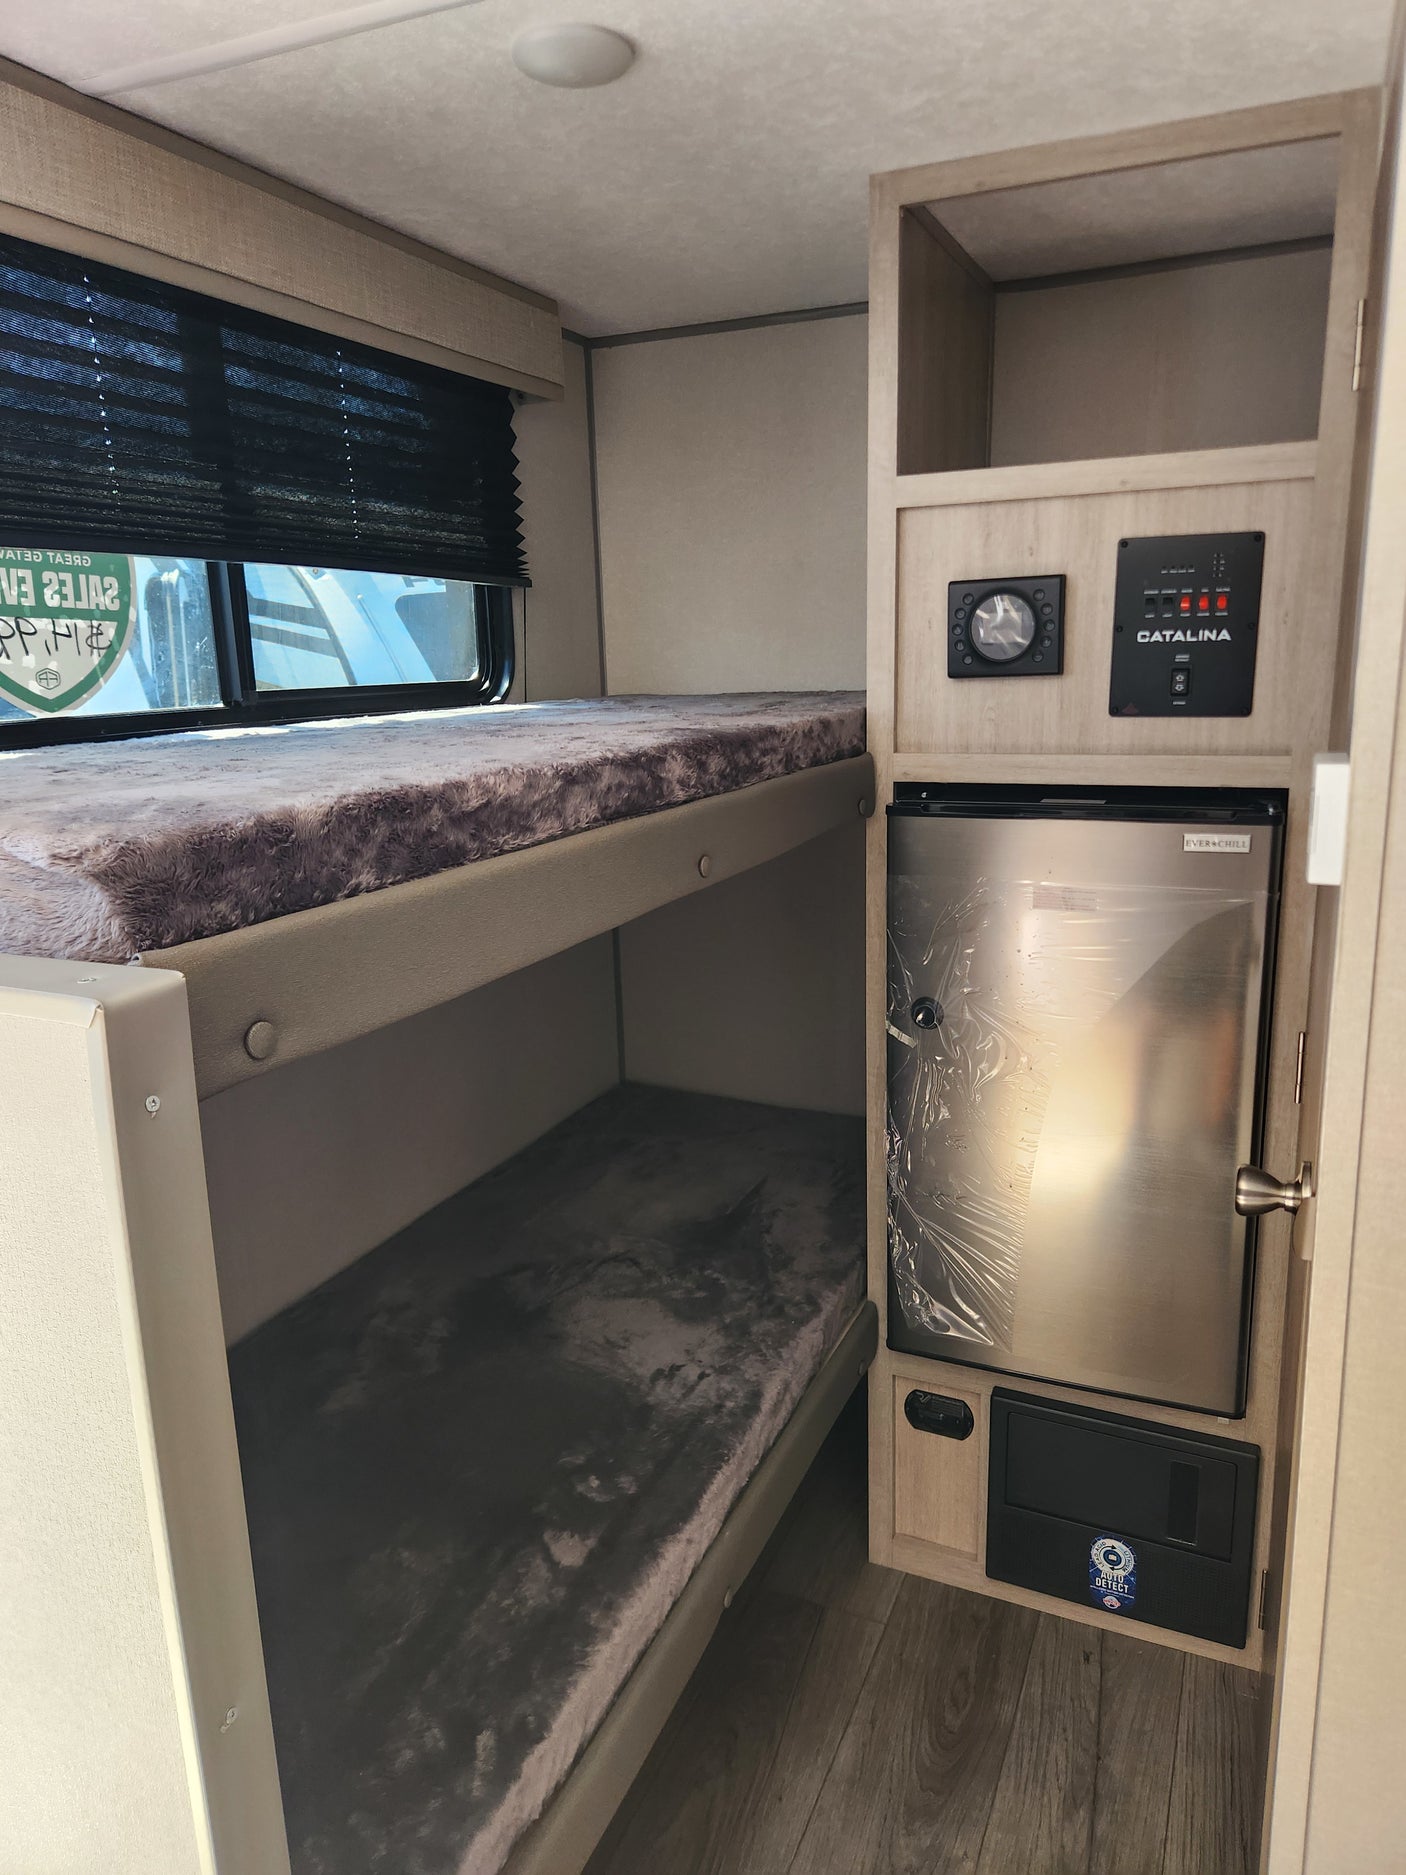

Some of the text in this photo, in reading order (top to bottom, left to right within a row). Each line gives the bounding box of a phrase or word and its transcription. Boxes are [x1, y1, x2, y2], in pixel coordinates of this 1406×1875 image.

[1137, 628, 1232, 643] CATALINA
[1218, 840, 1248, 849] CHILL
[1101, 1571, 1124, 1584] AUTO
[1095, 1577, 1129, 1593] DETECT
